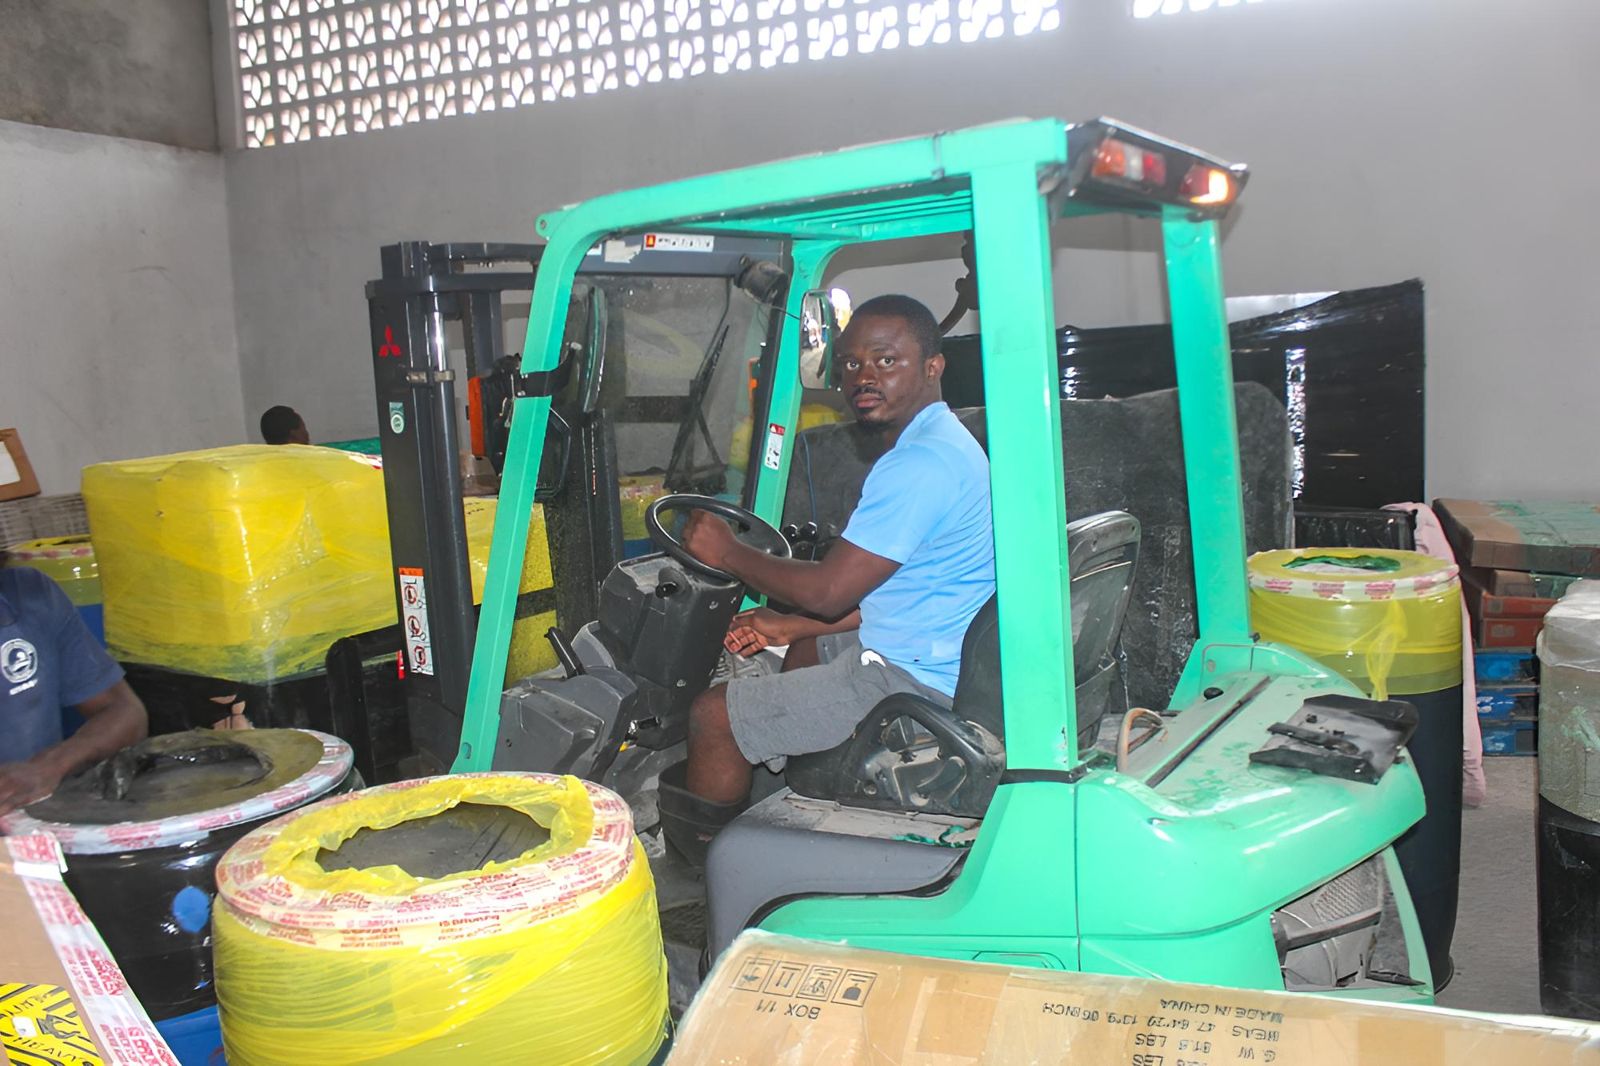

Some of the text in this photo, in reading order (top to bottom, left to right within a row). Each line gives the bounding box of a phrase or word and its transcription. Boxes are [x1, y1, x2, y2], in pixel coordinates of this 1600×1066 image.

[756, 999, 822, 1020] BOX 1/1
[1160, 998, 1284, 1024] MADE IN CHINA
[1134, 1032, 1167, 1048] LBS
